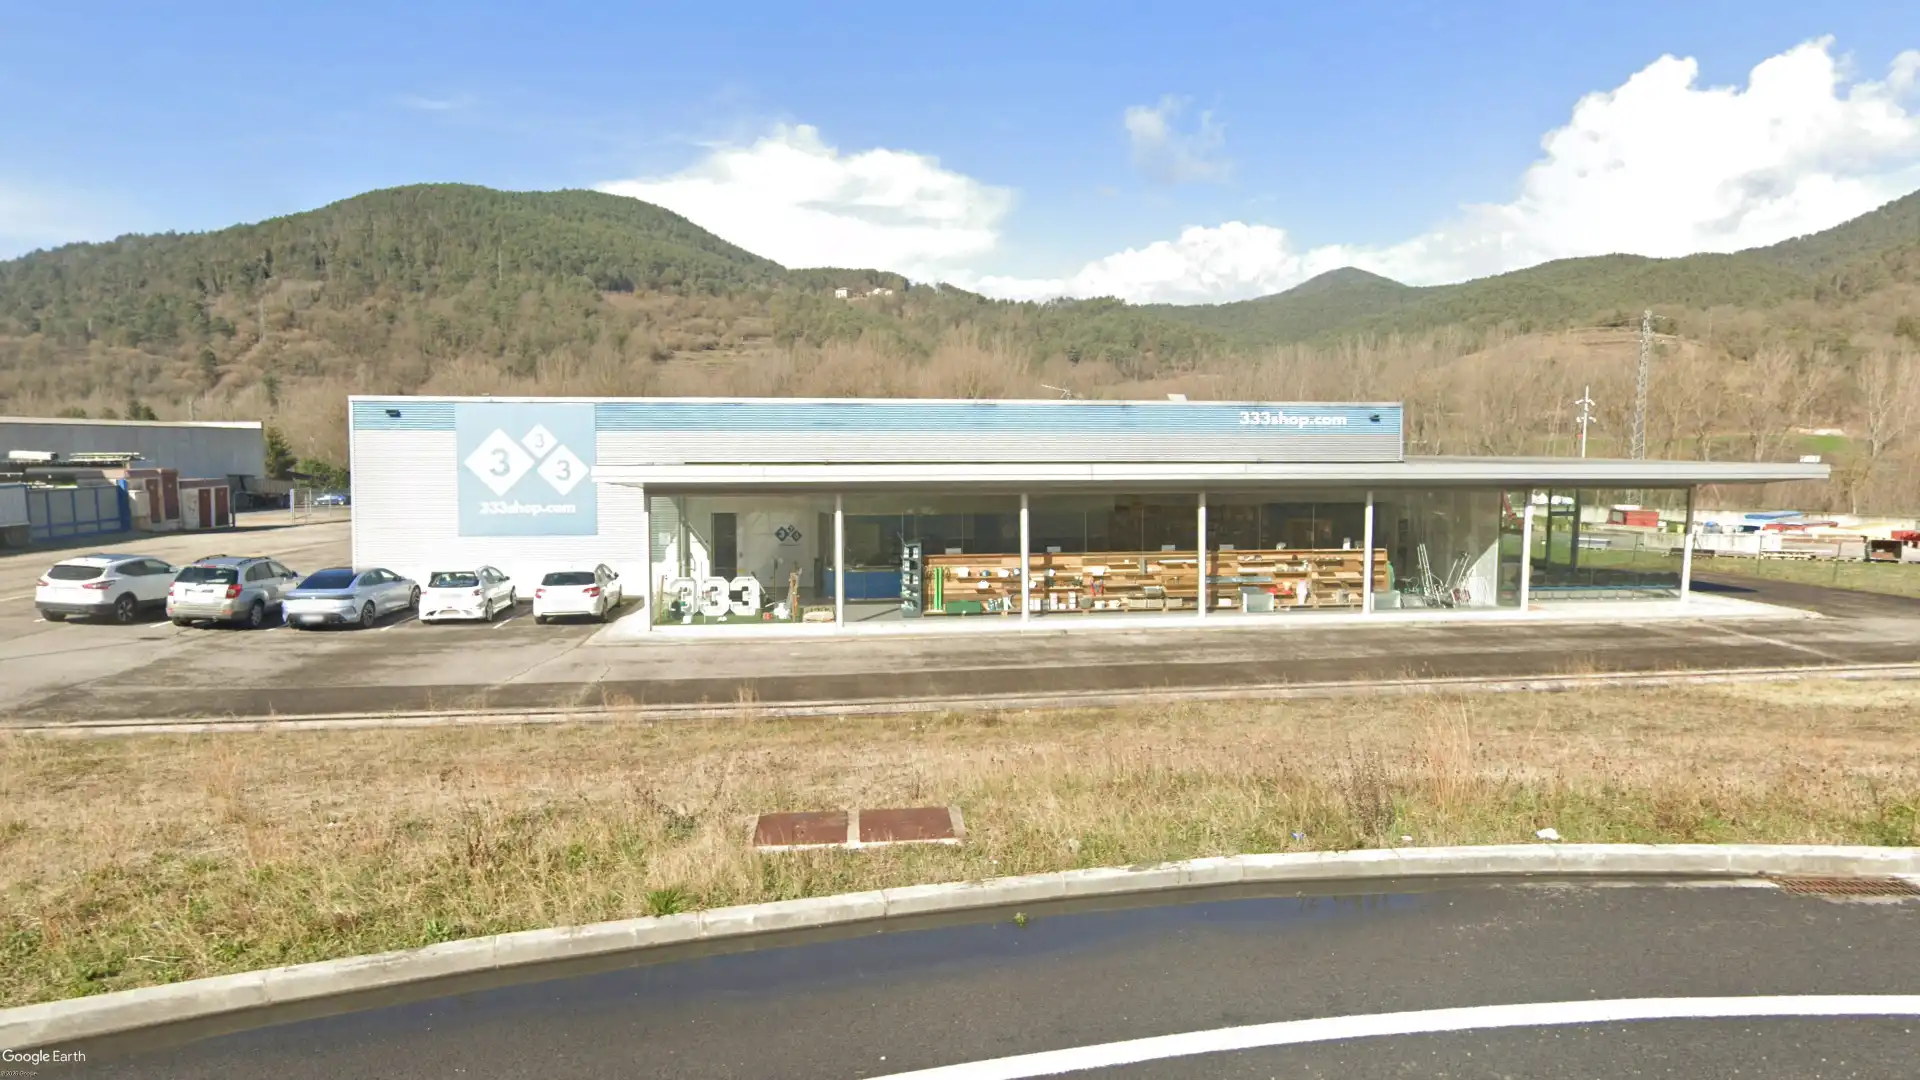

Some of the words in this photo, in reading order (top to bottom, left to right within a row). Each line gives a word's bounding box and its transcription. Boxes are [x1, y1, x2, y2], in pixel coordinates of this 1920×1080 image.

[1239, 411, 1347, 428] 333shop.com
[535, 433, 545, 448] 3
[489, 448, 511, 477] 3
[556, 460, 571, 481] 3
[479, 501, 576, 516] 333shop.com
[669, 576, 760, 617] 333
